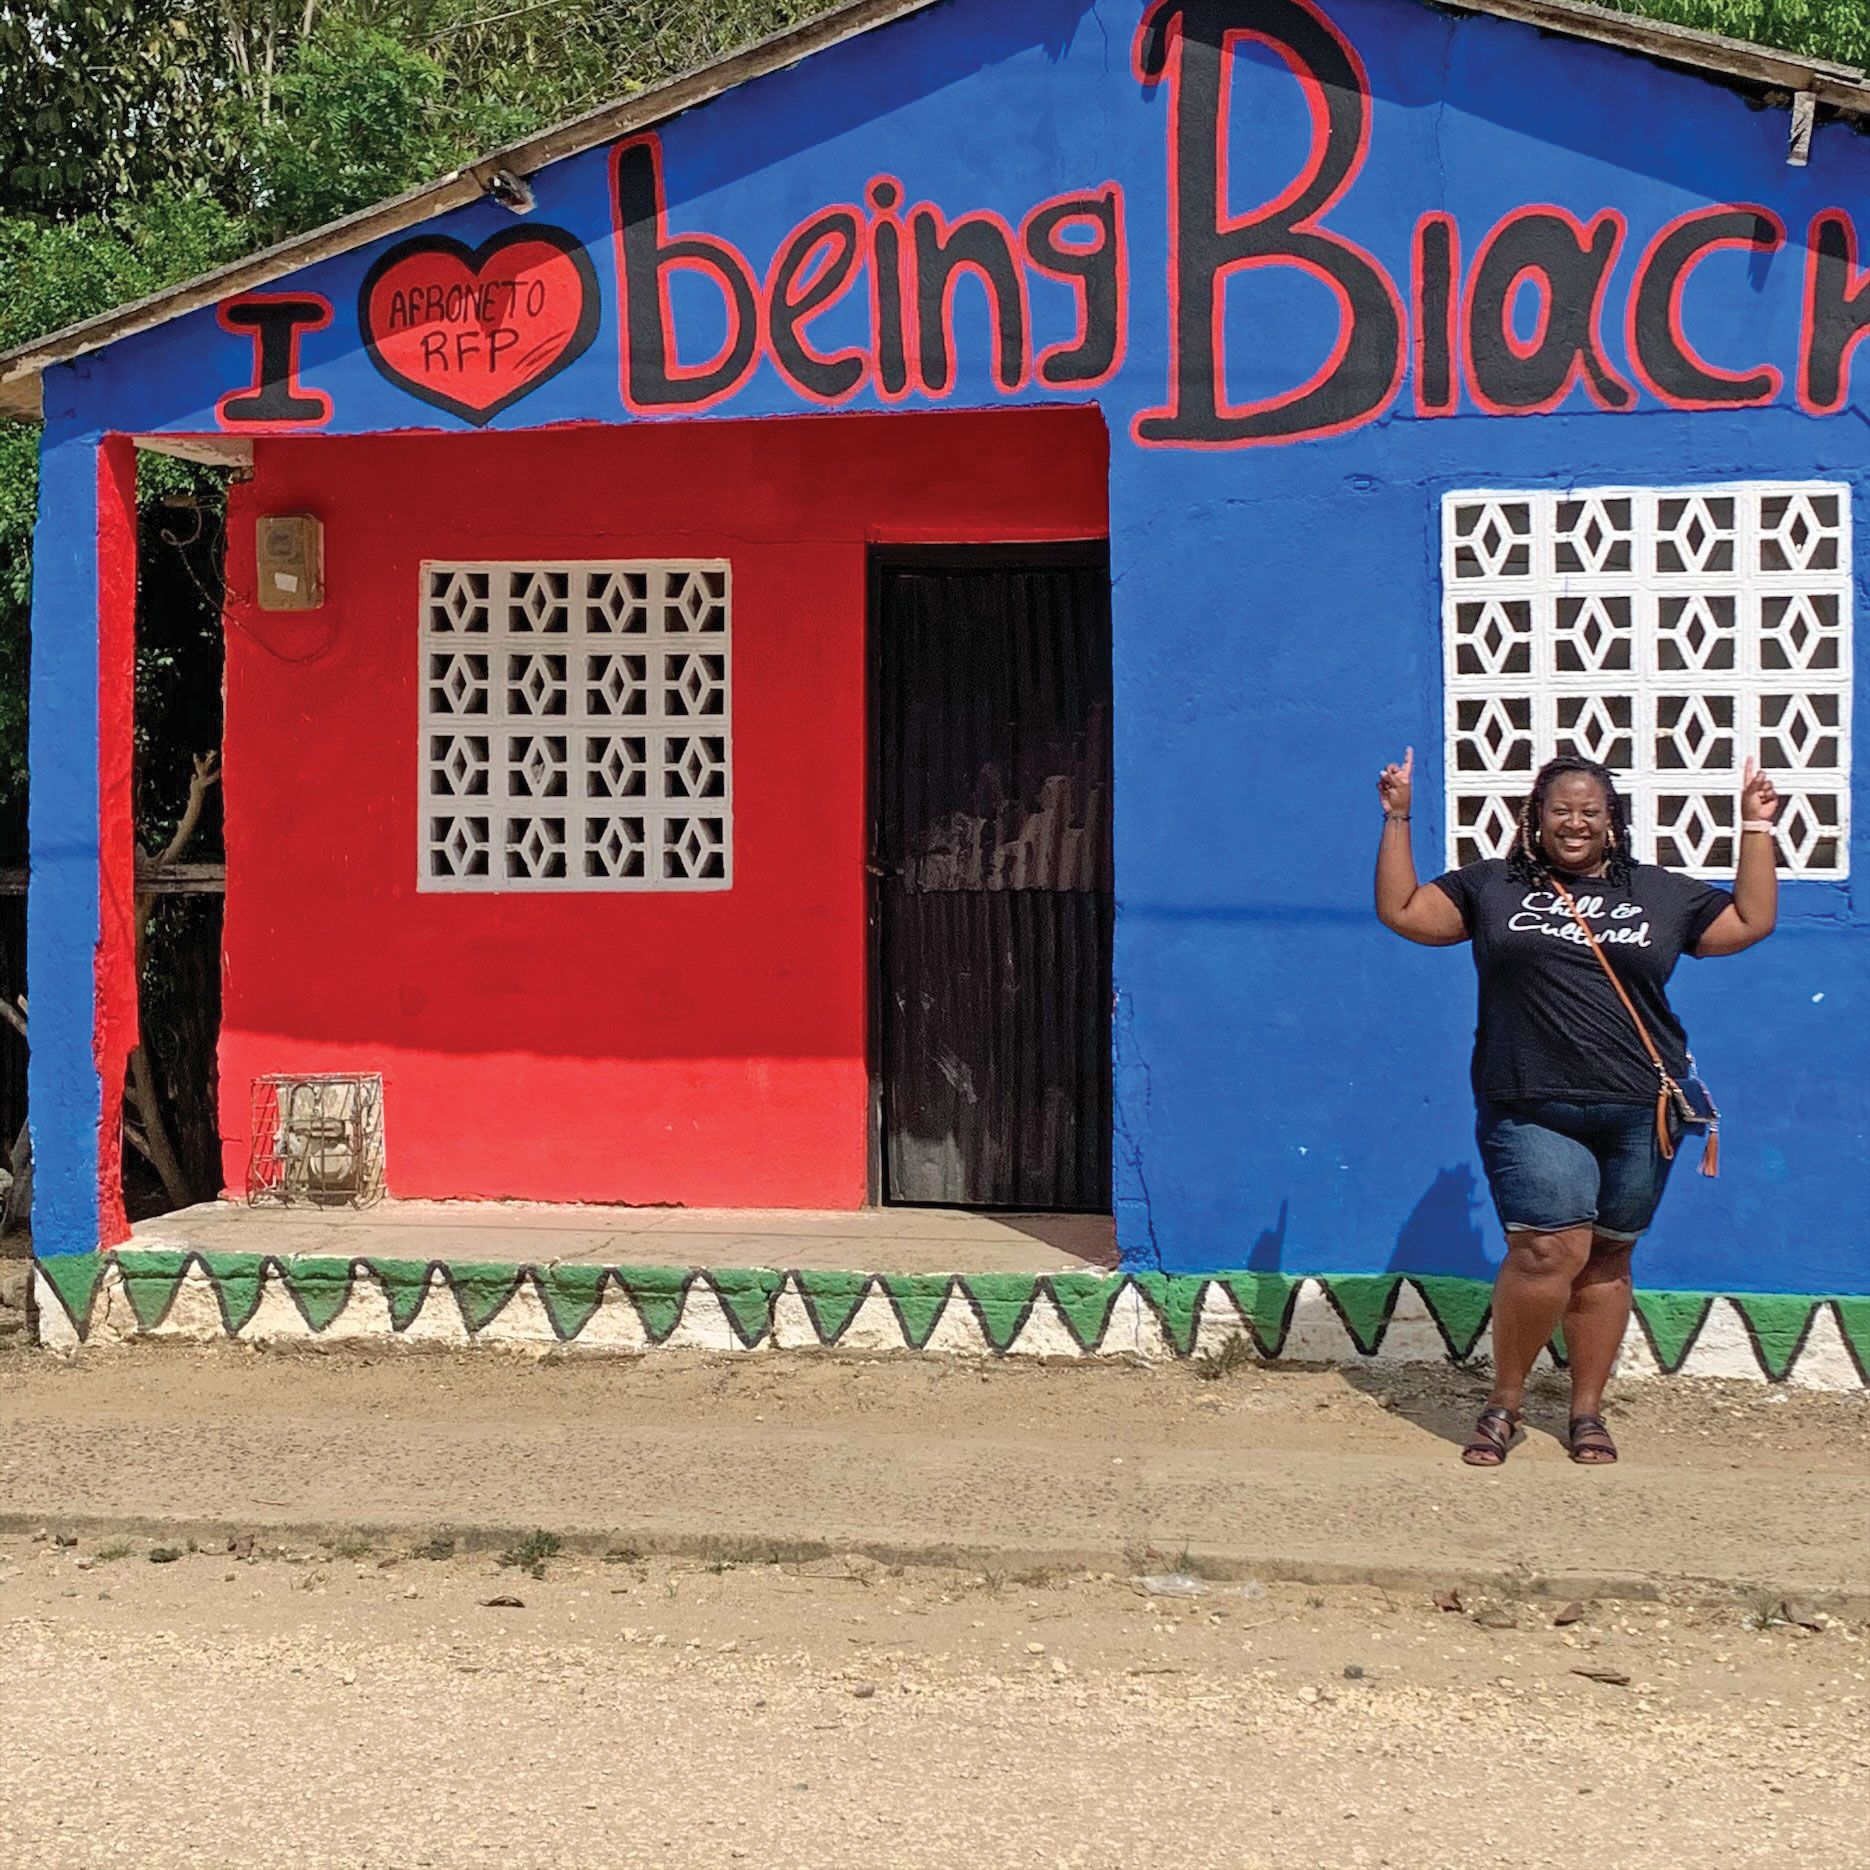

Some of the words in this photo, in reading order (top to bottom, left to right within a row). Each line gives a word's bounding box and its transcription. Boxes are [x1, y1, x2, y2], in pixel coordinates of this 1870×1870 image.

[216, 292, 333, 430] I
[608, 131, 1128, 416] being
[389, 279, 545, 329] AFRONETO
[420, 328, 520, 373] RFP
[1610, 902, 1643, 919] &
